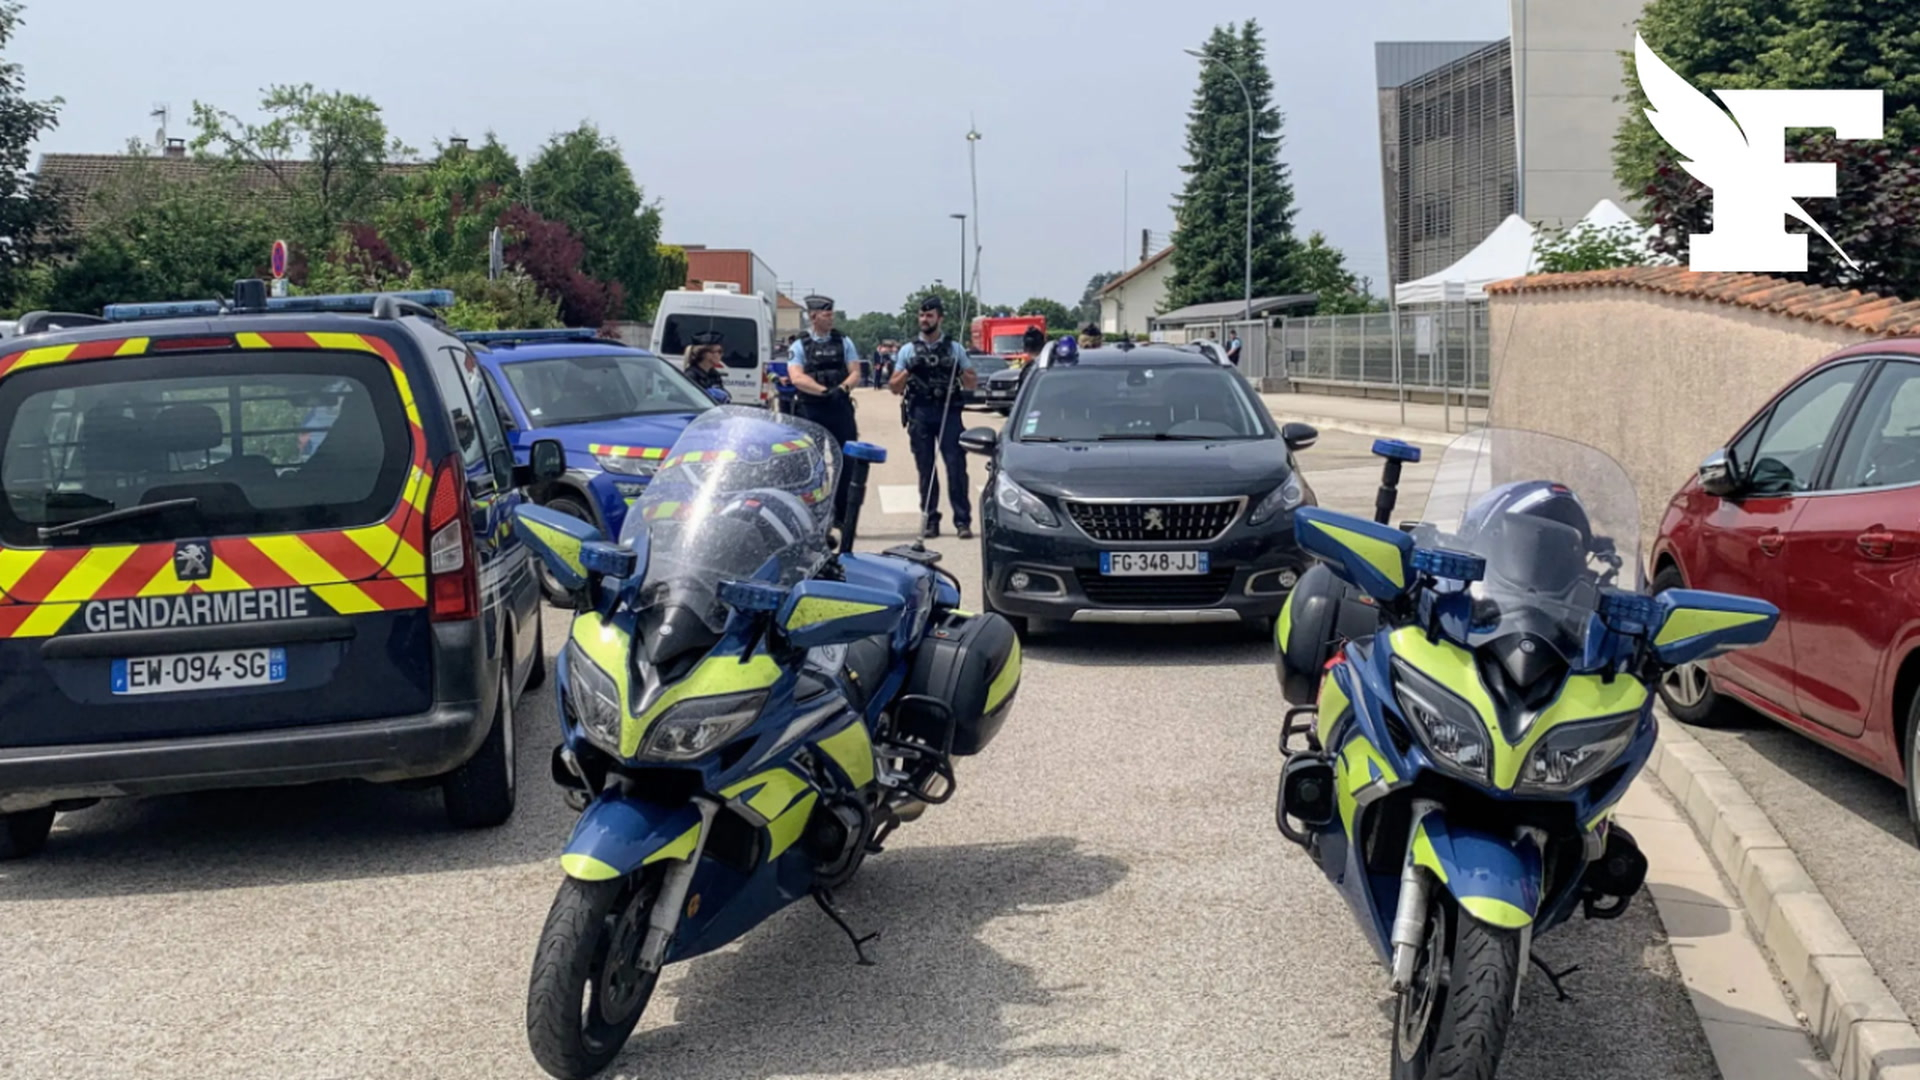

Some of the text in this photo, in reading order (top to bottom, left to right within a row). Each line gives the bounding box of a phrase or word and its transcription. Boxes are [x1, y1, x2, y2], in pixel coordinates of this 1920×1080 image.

[1112, 553, 1196, 571] FG-348-JJ
[85, 587, 308, 632] GENDARMERIE
[130, 651, 266, 687] EW-094-SG
[272, 664, 282, 678] 51
